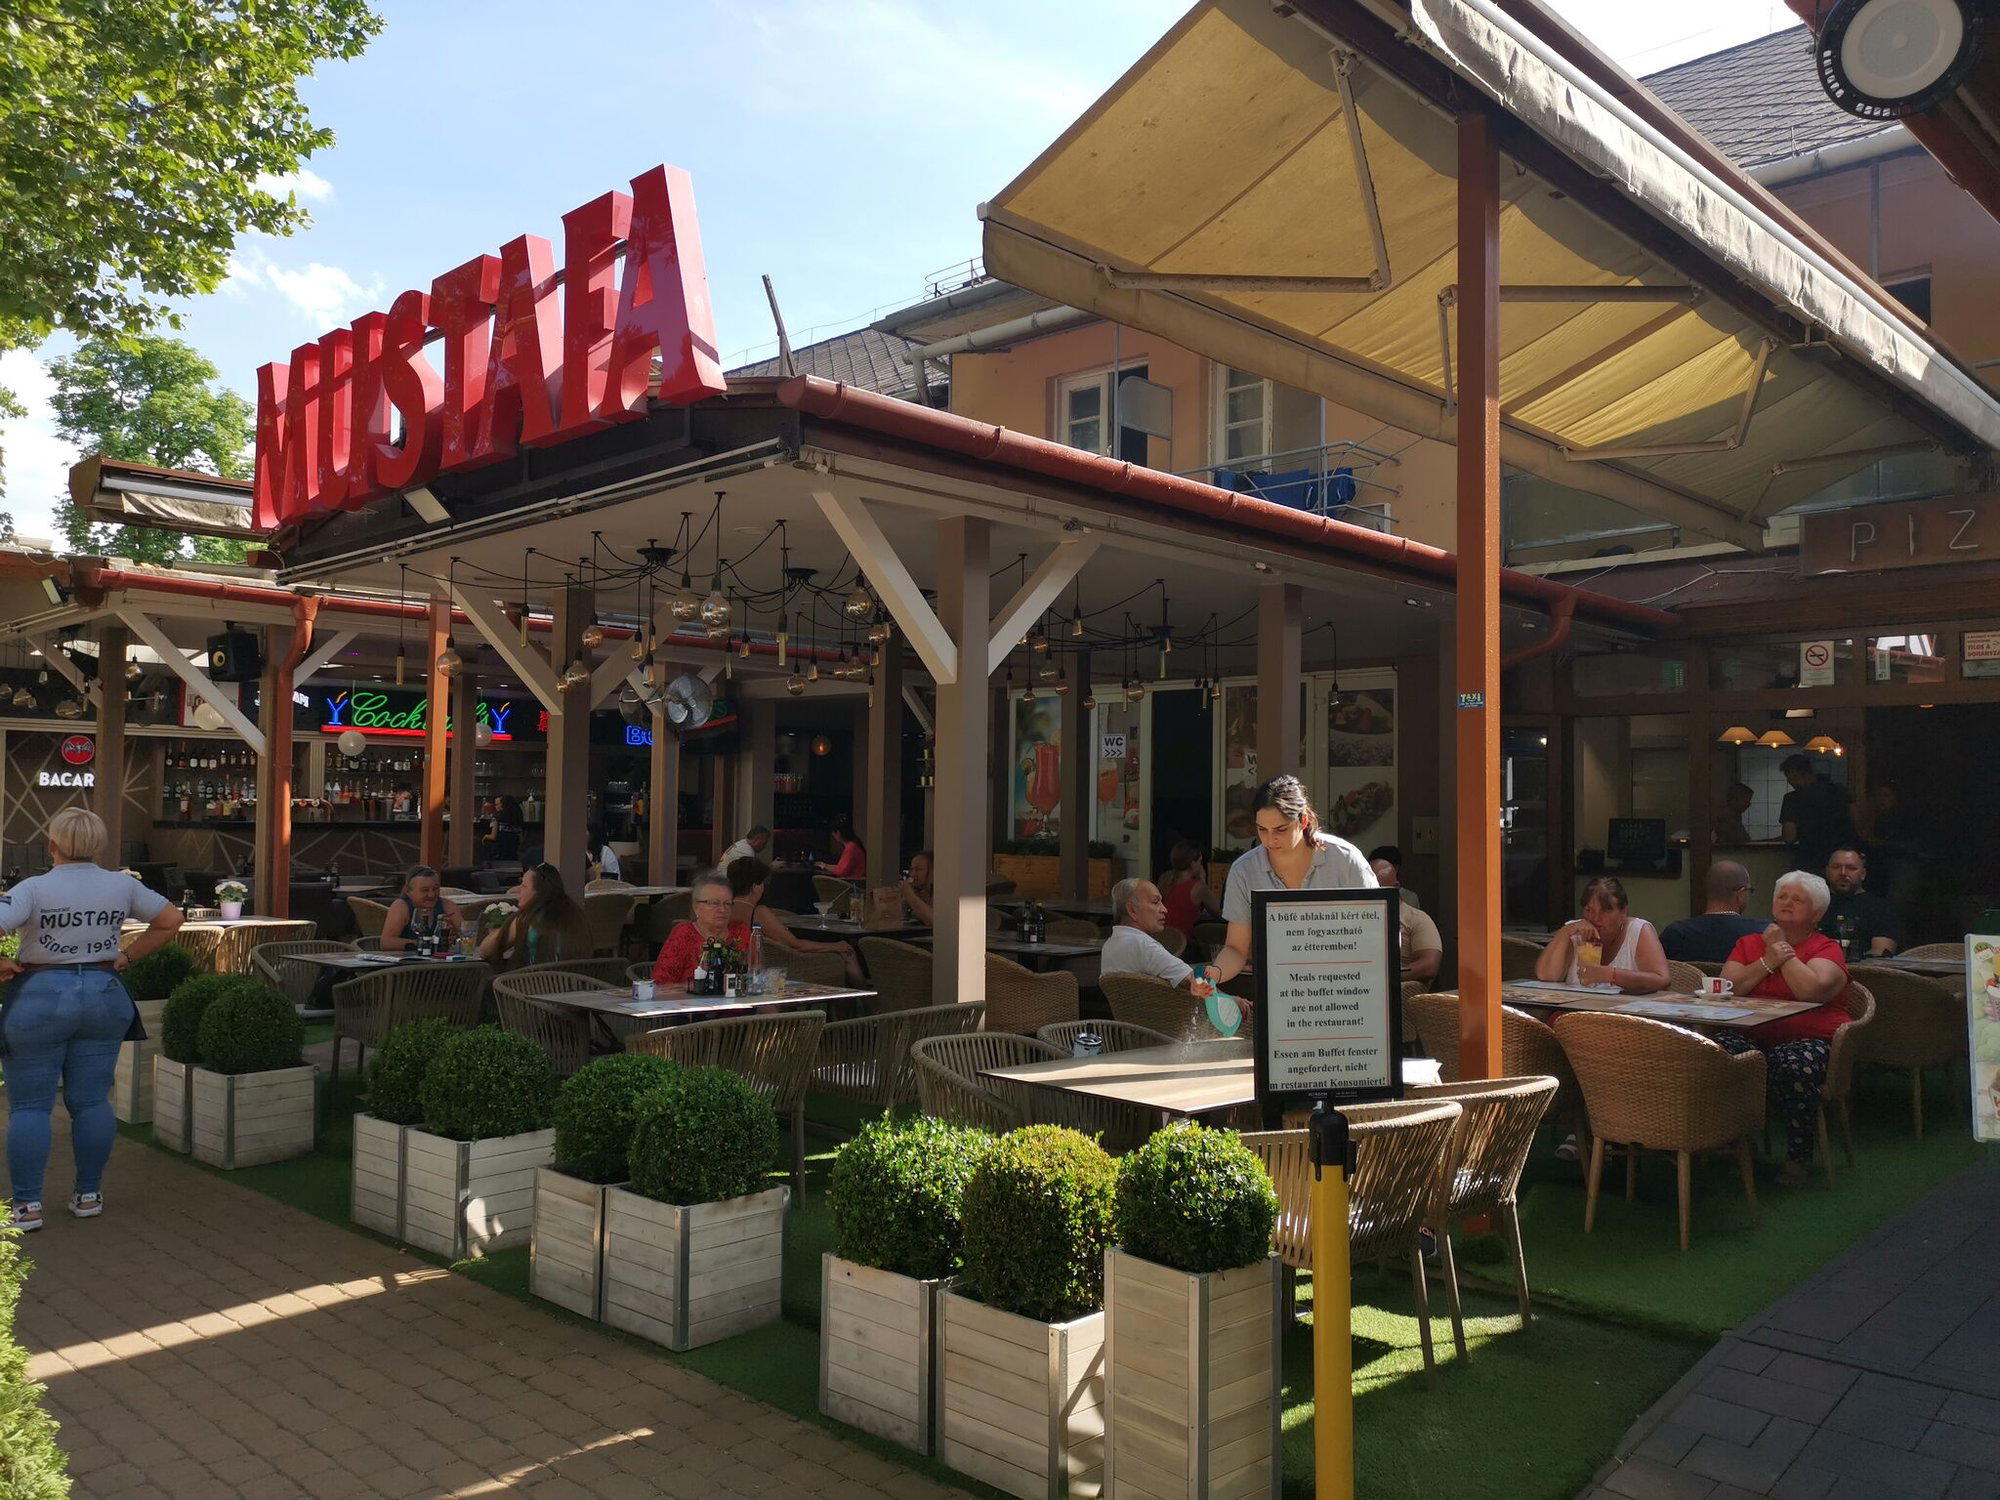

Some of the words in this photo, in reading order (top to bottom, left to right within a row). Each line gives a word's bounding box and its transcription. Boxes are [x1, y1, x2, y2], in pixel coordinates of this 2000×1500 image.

[251, 162, 727, 531] MUSTAFA
[1104, 737, 1124, 746] WC
[40, 910, 125, 929] MUSTAFA
[1268, 913, 1276, 922] A
[1300, 911, 1339, 921] ablaknál
[1341, 911, 1359, 920] kért
[1286, 929, 1305, 937] nem
[1307, 926, 1363, 938] fogyasztható
[40, 934, 79, 954] Since
[1291, 944, 1302, 952] az
[1304, 941, 1358, 952] étteremben!
[1289, 972, 1316, 982] Meals
[1318, 971, 1361, 984] requested
[1280, 988, 1289, 998] at
[1291, 987, 1305, 997] the
[1307, 986, 1334, 997] buffet
[1336, 986, 1371, 996] window
[1291, 1005, 1307, 1013] are
[1308, 1004, 1323, 1012] not
[1325, 1001, 1359, 1012] allowed
[1287, 1019, 1296, 1028] in
[1298, 1018, 1313, 1027] the
[1314, 1016, 1365, 1027] restaurant!
[1273, 1049, 1299, 1059] Essen
[1301, 1051, 1315, 1059] am
[1318, 1047, 1346, 1058] Buffet
[1348, 1046, 1379, 1057] fenster
[1287, 1063, 1343, 1075] angefordert,
[1345, 1062, 1368, 1072] nicht
[1280, 1080, 1328, 1089] restaurant
[1330, 1076, 1386, 1088] Konsumiert!
